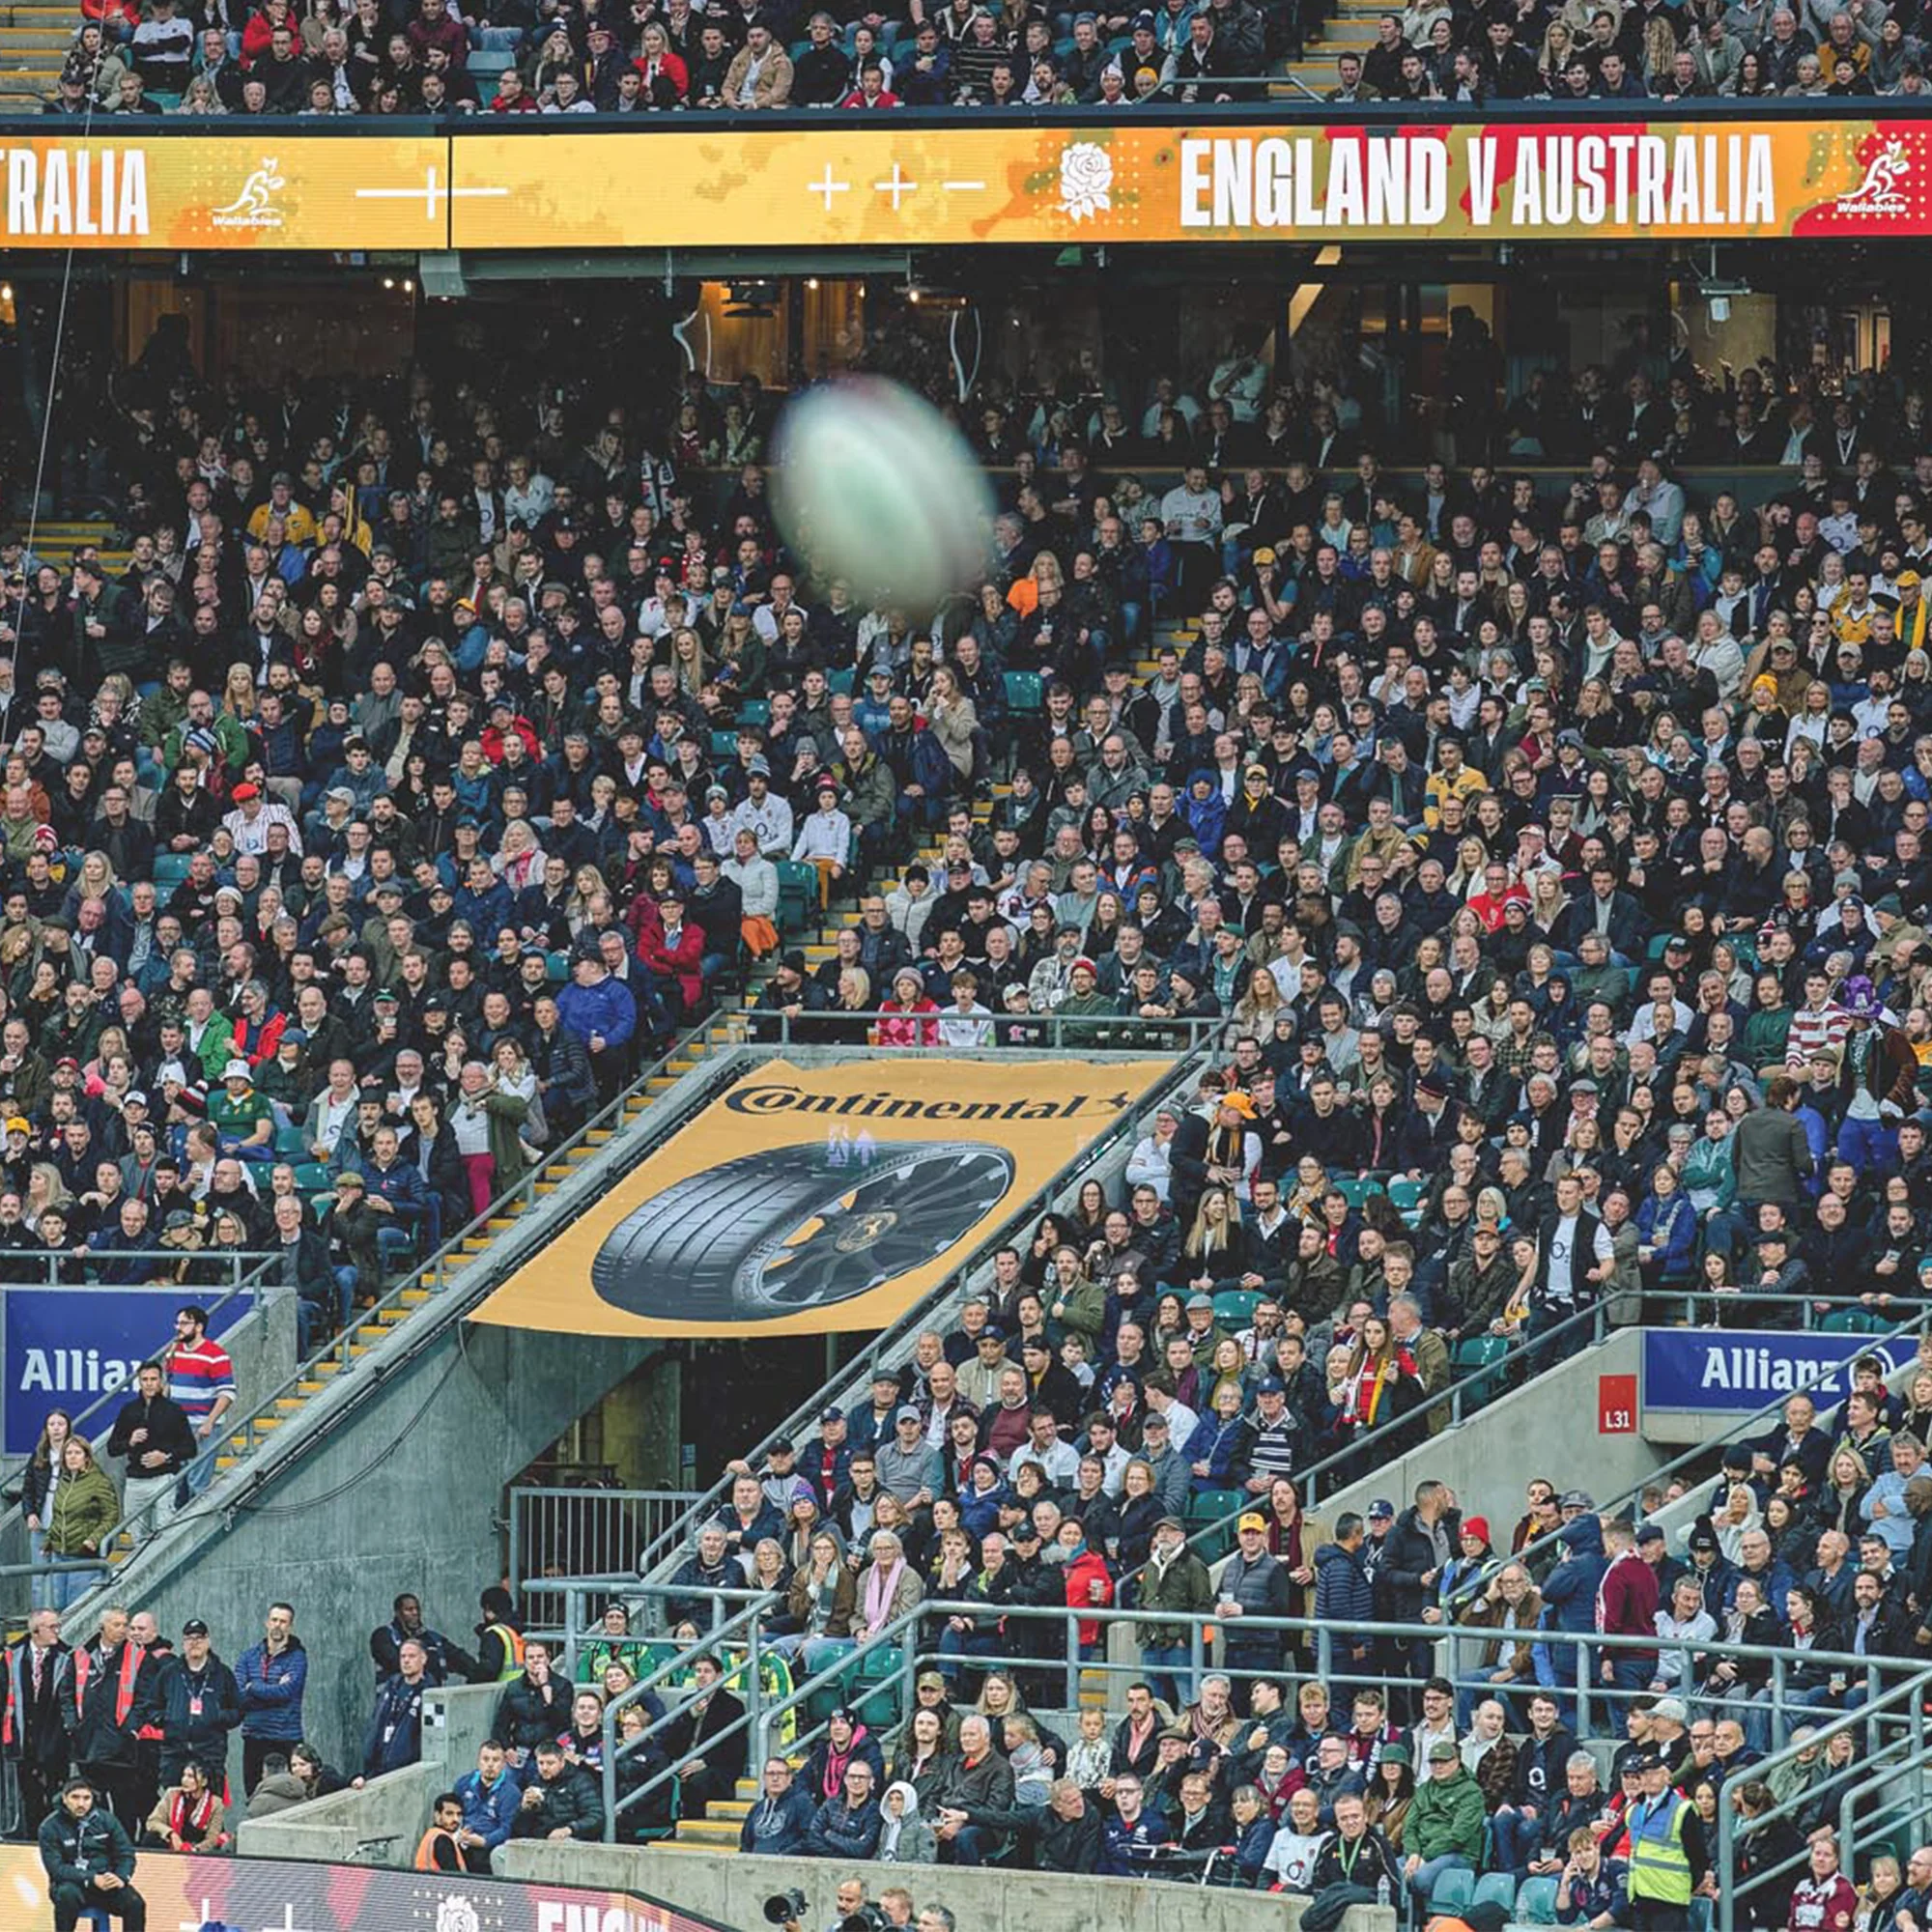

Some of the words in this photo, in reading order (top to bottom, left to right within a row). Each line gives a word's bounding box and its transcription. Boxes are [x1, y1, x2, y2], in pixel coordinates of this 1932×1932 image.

[0, 149, 150, 235] RALIA
[1180, 137, 1447, 227] ENGLAND
[1467, 137, 1496, 225] V
[1512, 134, 1775, 225] AUSTRALIA
[1836, 200, 1907, 213] Wallabies
[724, 1084, 1090, 1121] Continental
[19, 1349, 143, 1392] Allia
[1604, 1410, 1630, 1429] L31
